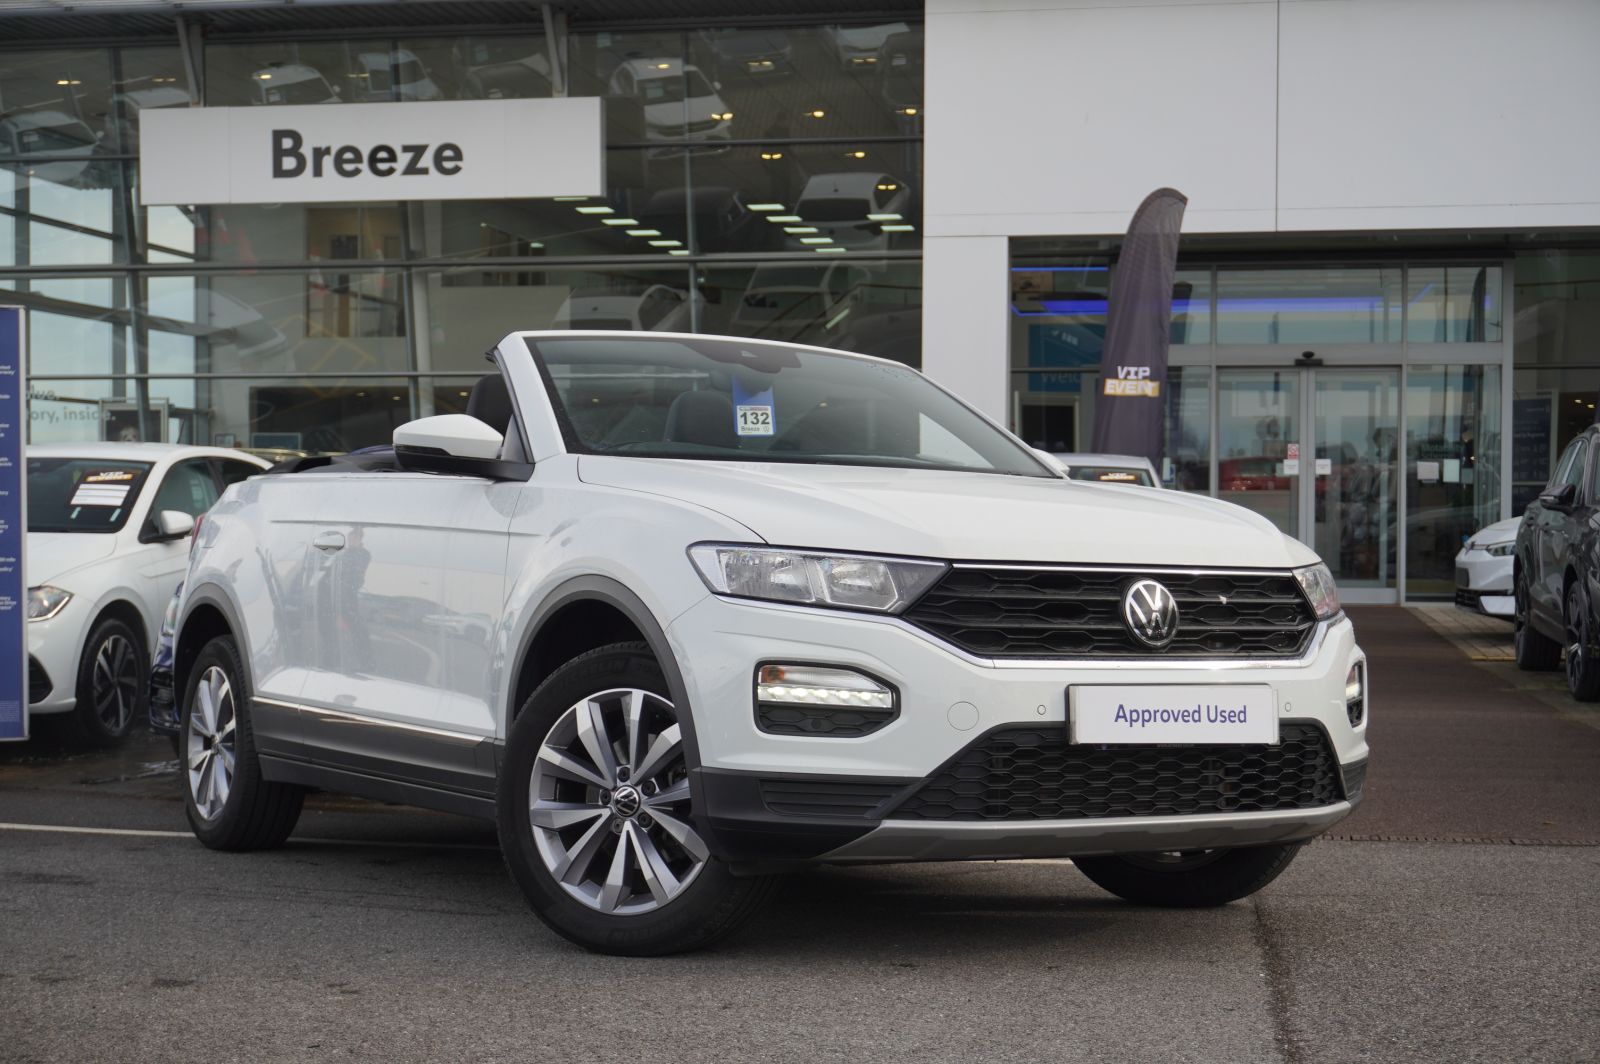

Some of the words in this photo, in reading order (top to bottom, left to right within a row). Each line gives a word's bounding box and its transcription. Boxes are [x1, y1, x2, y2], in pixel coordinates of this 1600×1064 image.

[272, 129, 464, 178] Breeze
[1117, 366, 1151, 379] VIP
[1105, 379, 1157, 395] EVENT
[740, 412, 770, 425] 132
[1114, 703, 1201, 727] Approved
[1206, 704, 1247, 724] Used
